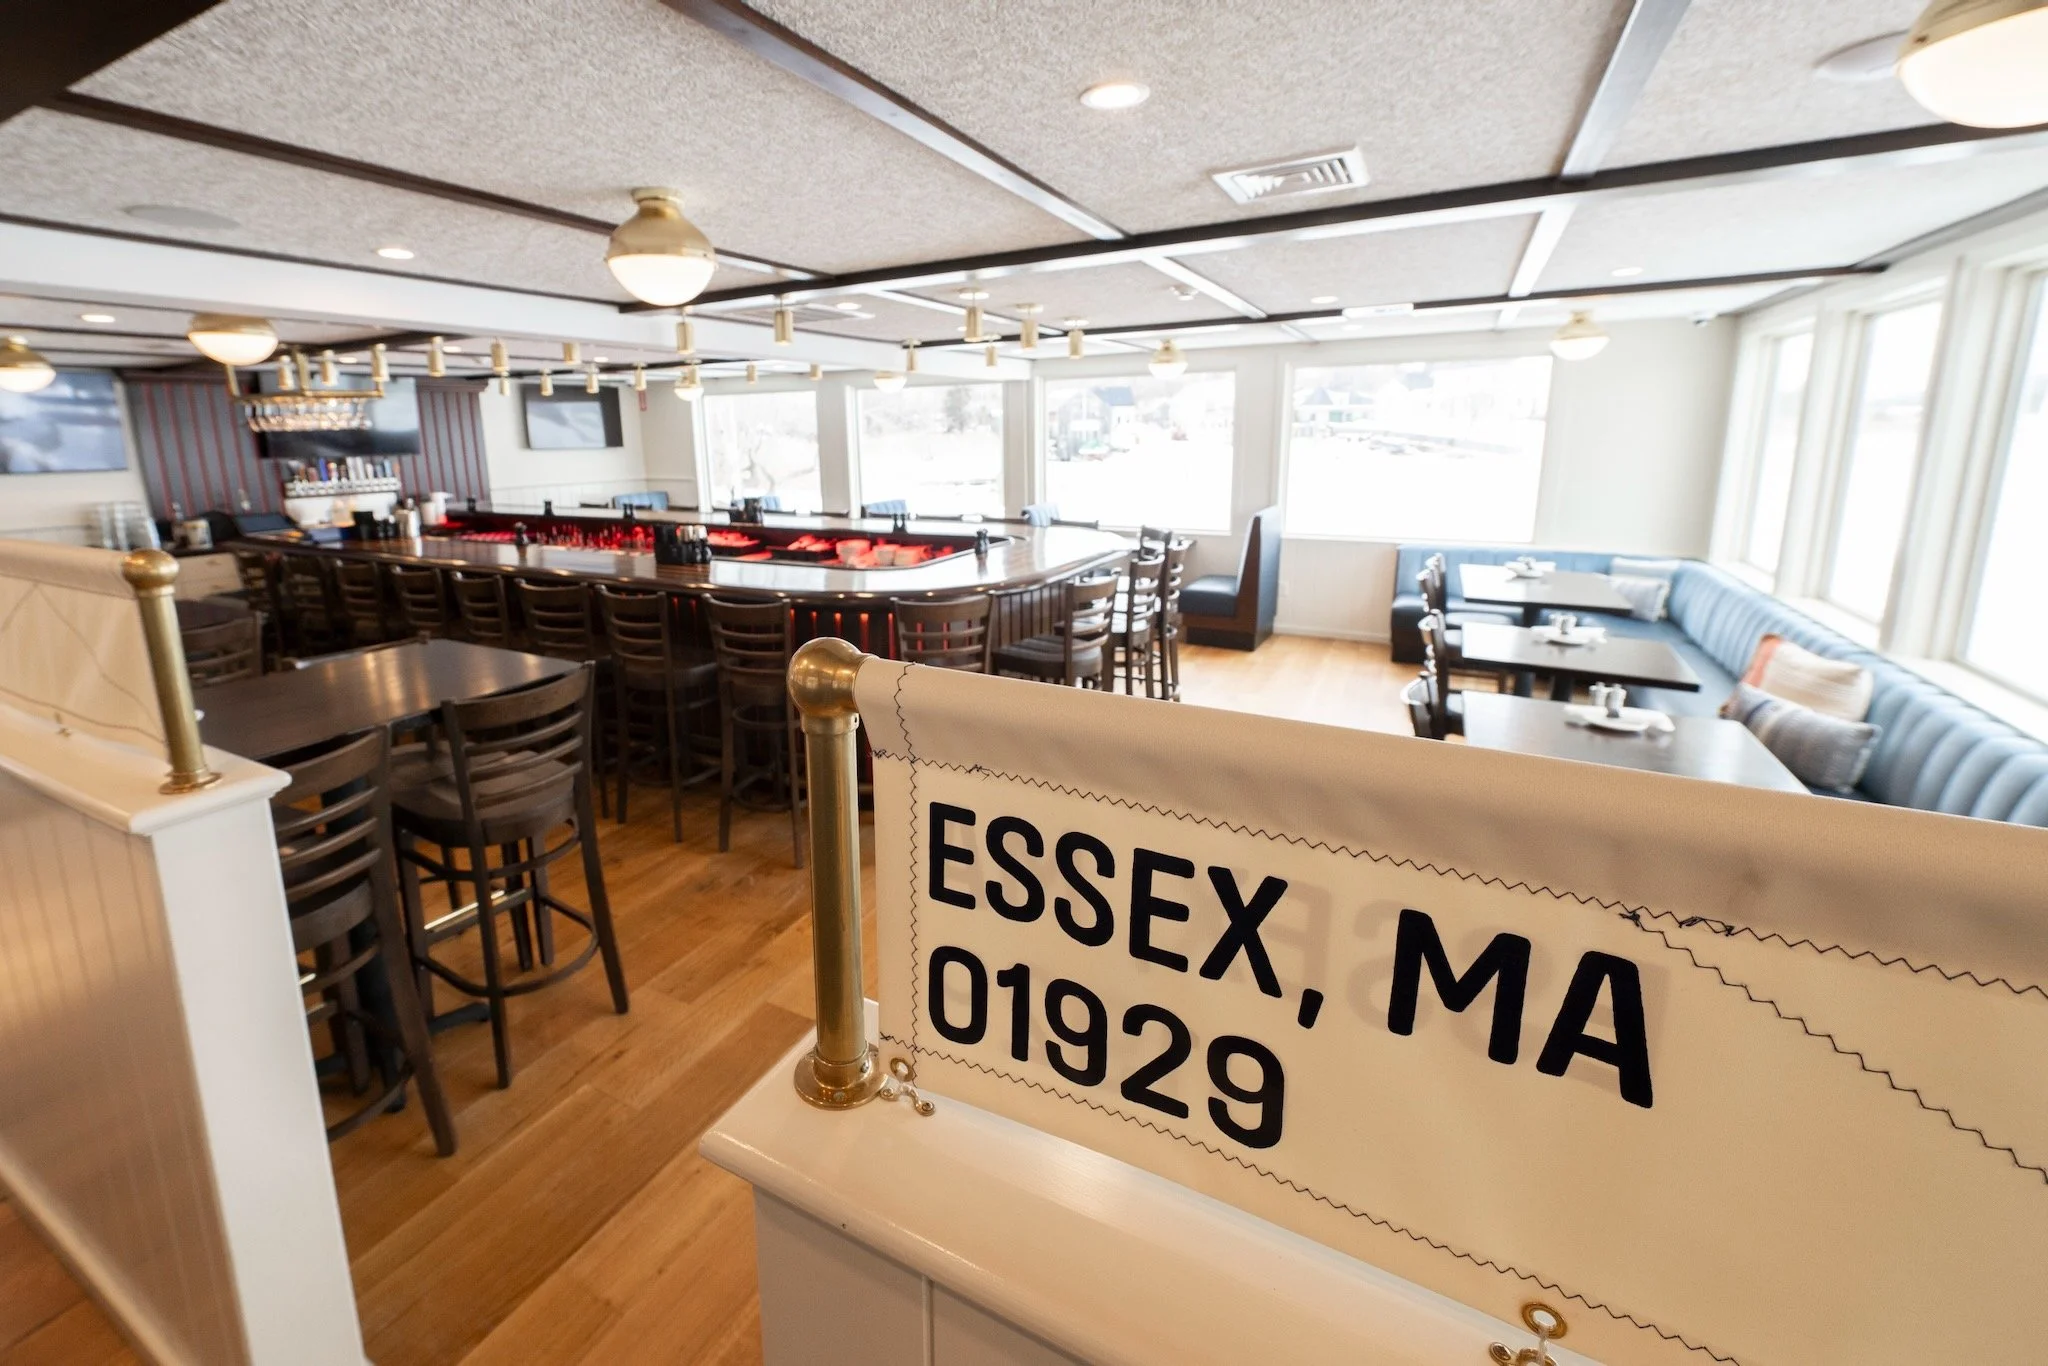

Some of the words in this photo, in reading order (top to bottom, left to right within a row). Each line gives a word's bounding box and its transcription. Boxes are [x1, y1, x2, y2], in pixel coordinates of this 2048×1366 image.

[928, 801, 1324, 1030] ESSEX,
[1387, 908, 1654, 1109] MA
[928, 945, 1285, 1149] 01929
